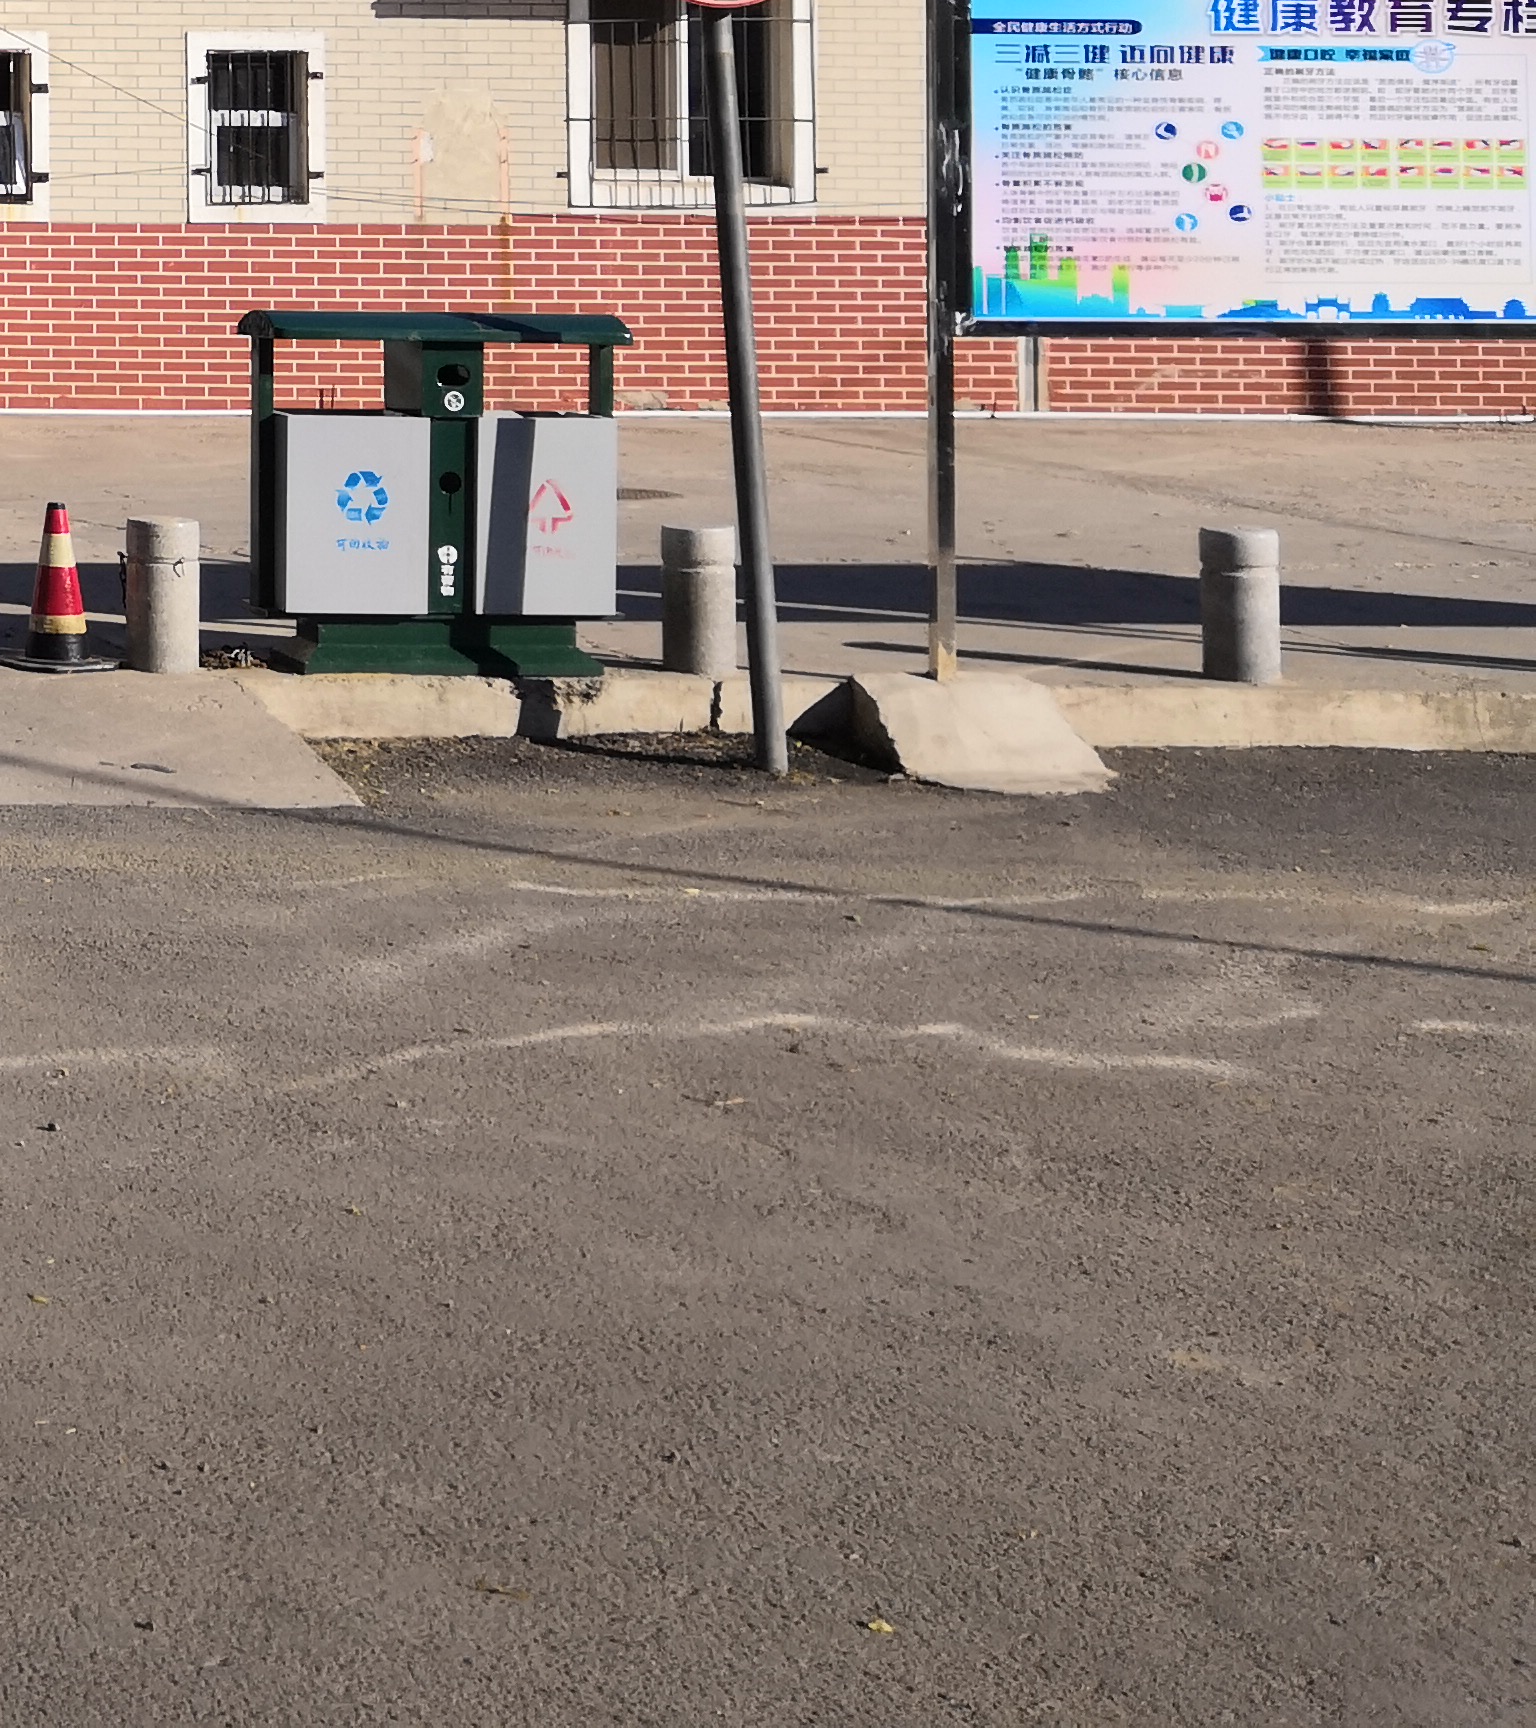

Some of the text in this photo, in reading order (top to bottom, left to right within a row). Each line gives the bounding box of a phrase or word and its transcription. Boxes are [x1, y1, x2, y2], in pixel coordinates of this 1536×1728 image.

[992, 21, 1133, 34] 全民健康生活方式行动
[994, 43, 1235, 65] 三减三健 迈向健康
[1114, 68, 1184, 81] 核心信息
